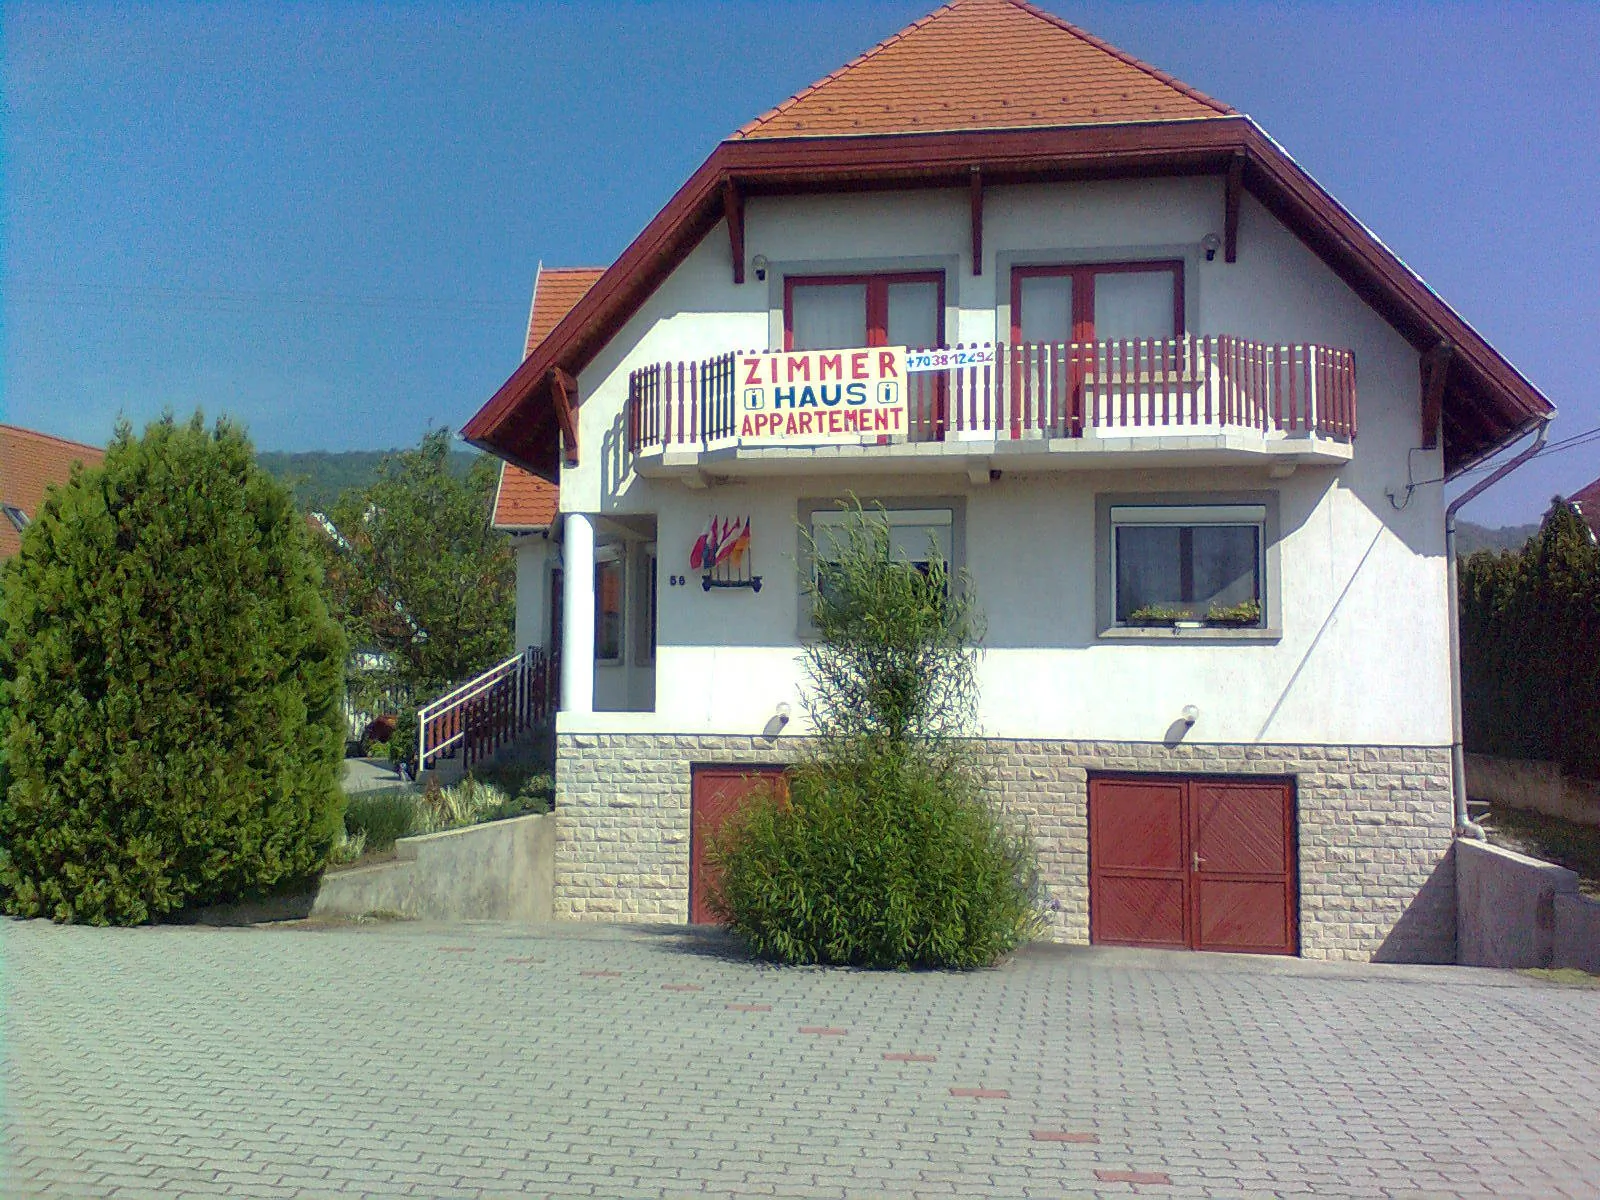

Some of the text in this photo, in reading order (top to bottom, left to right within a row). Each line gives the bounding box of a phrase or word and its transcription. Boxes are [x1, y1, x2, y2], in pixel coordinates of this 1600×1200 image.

[743, 351, 898, 385] ZIMMER
[774, 383, 867, 409] HAUS
[741, 407, 904, 437] APPARTEMENT
